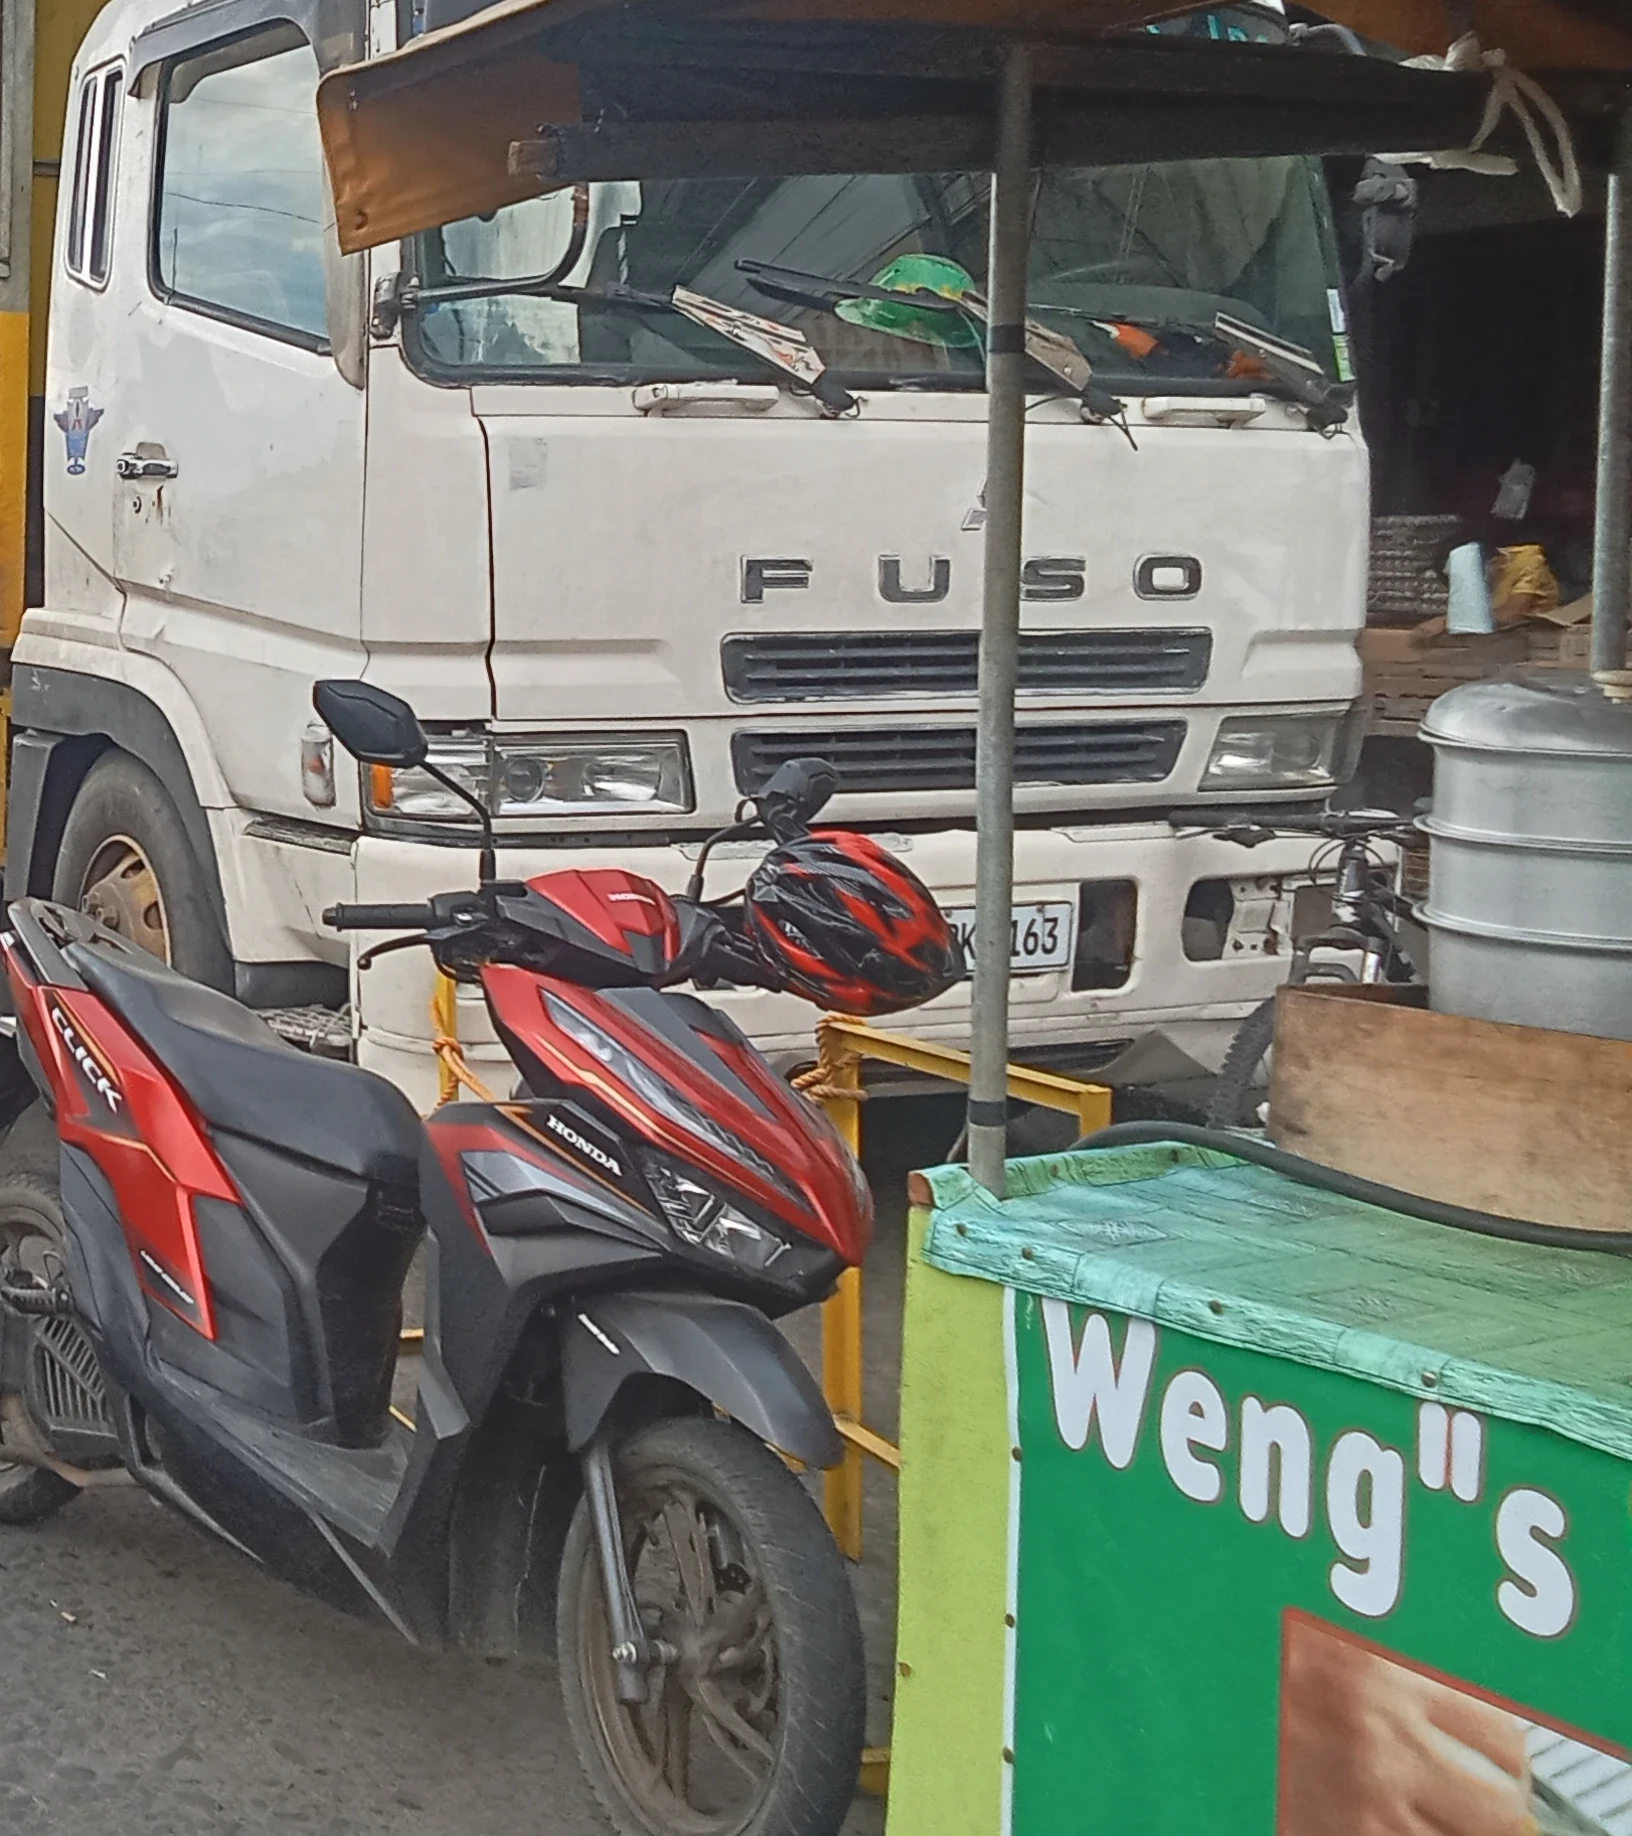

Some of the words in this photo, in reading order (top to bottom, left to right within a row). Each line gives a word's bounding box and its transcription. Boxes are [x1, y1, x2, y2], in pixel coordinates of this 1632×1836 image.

[740, 554, 1202, 603] FUSO
[51, 1007, 122, 1115] CLICK
[547, 1114, 623, 1177] HONDA
